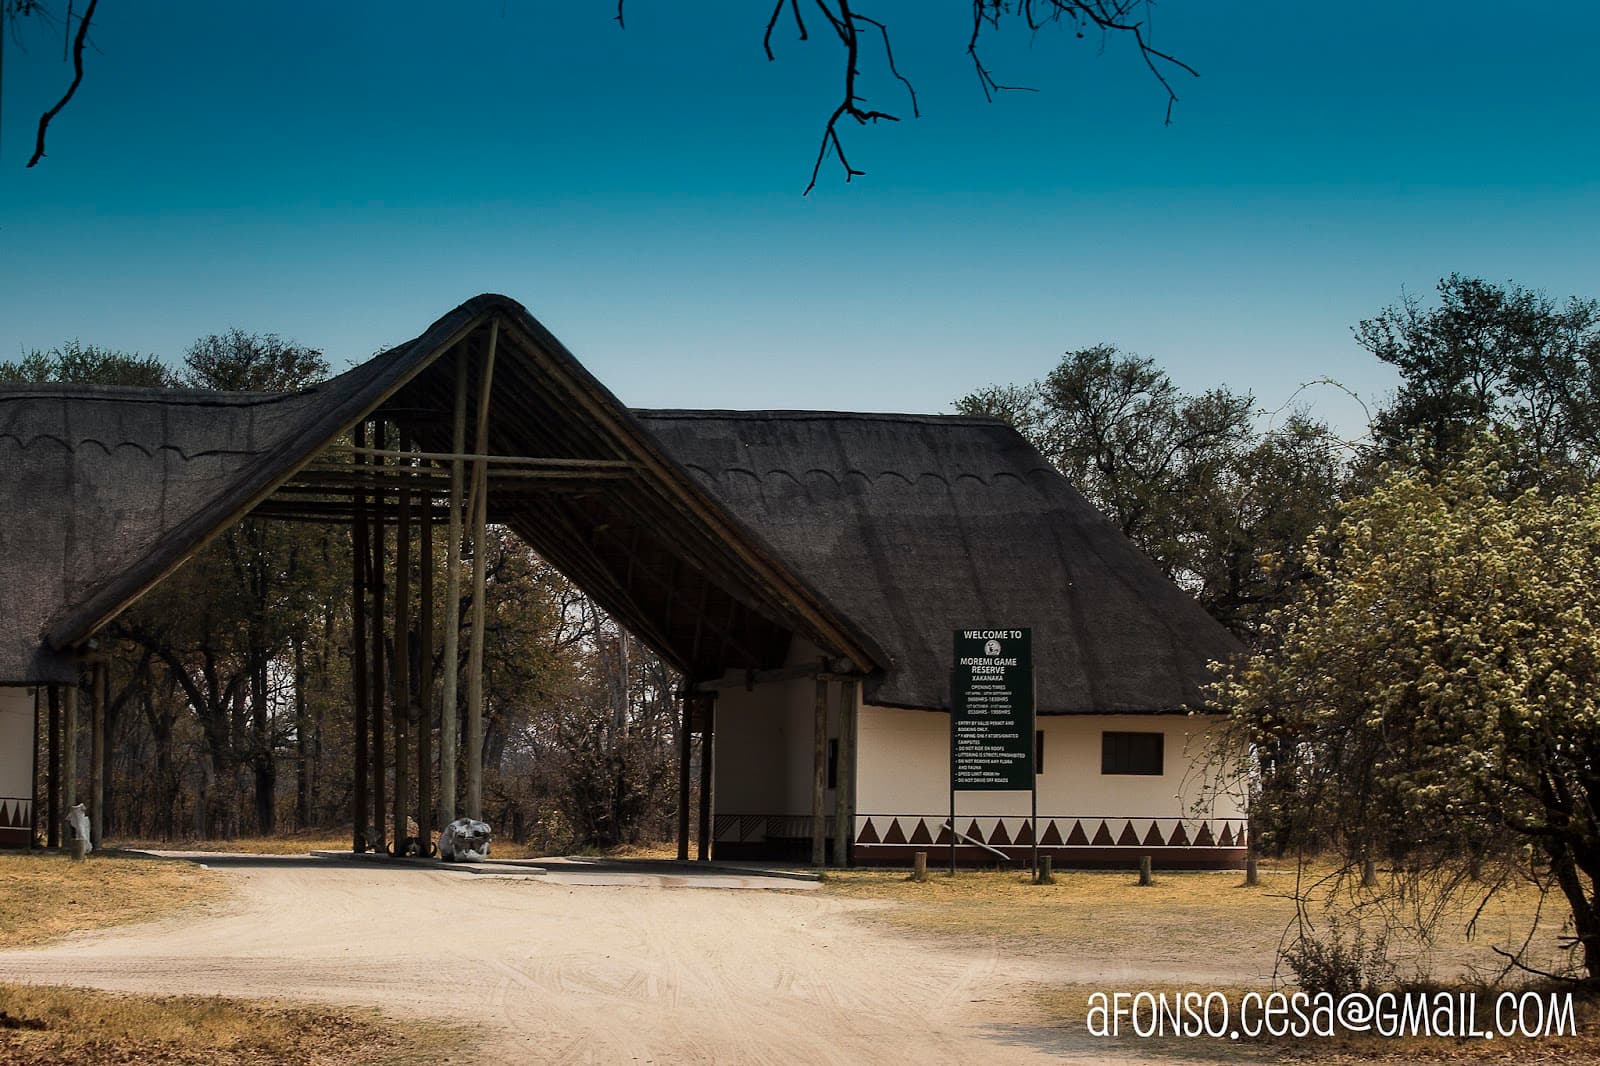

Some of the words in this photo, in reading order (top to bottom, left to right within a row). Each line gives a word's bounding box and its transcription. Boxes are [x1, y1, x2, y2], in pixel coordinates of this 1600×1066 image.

[964, 631, 1008, 639] WELCOME
[1010, 631, 1022, 639] TO
[994, 658, 1017, 666] GAME
[972, 666, 1006, 674] RESERVE
